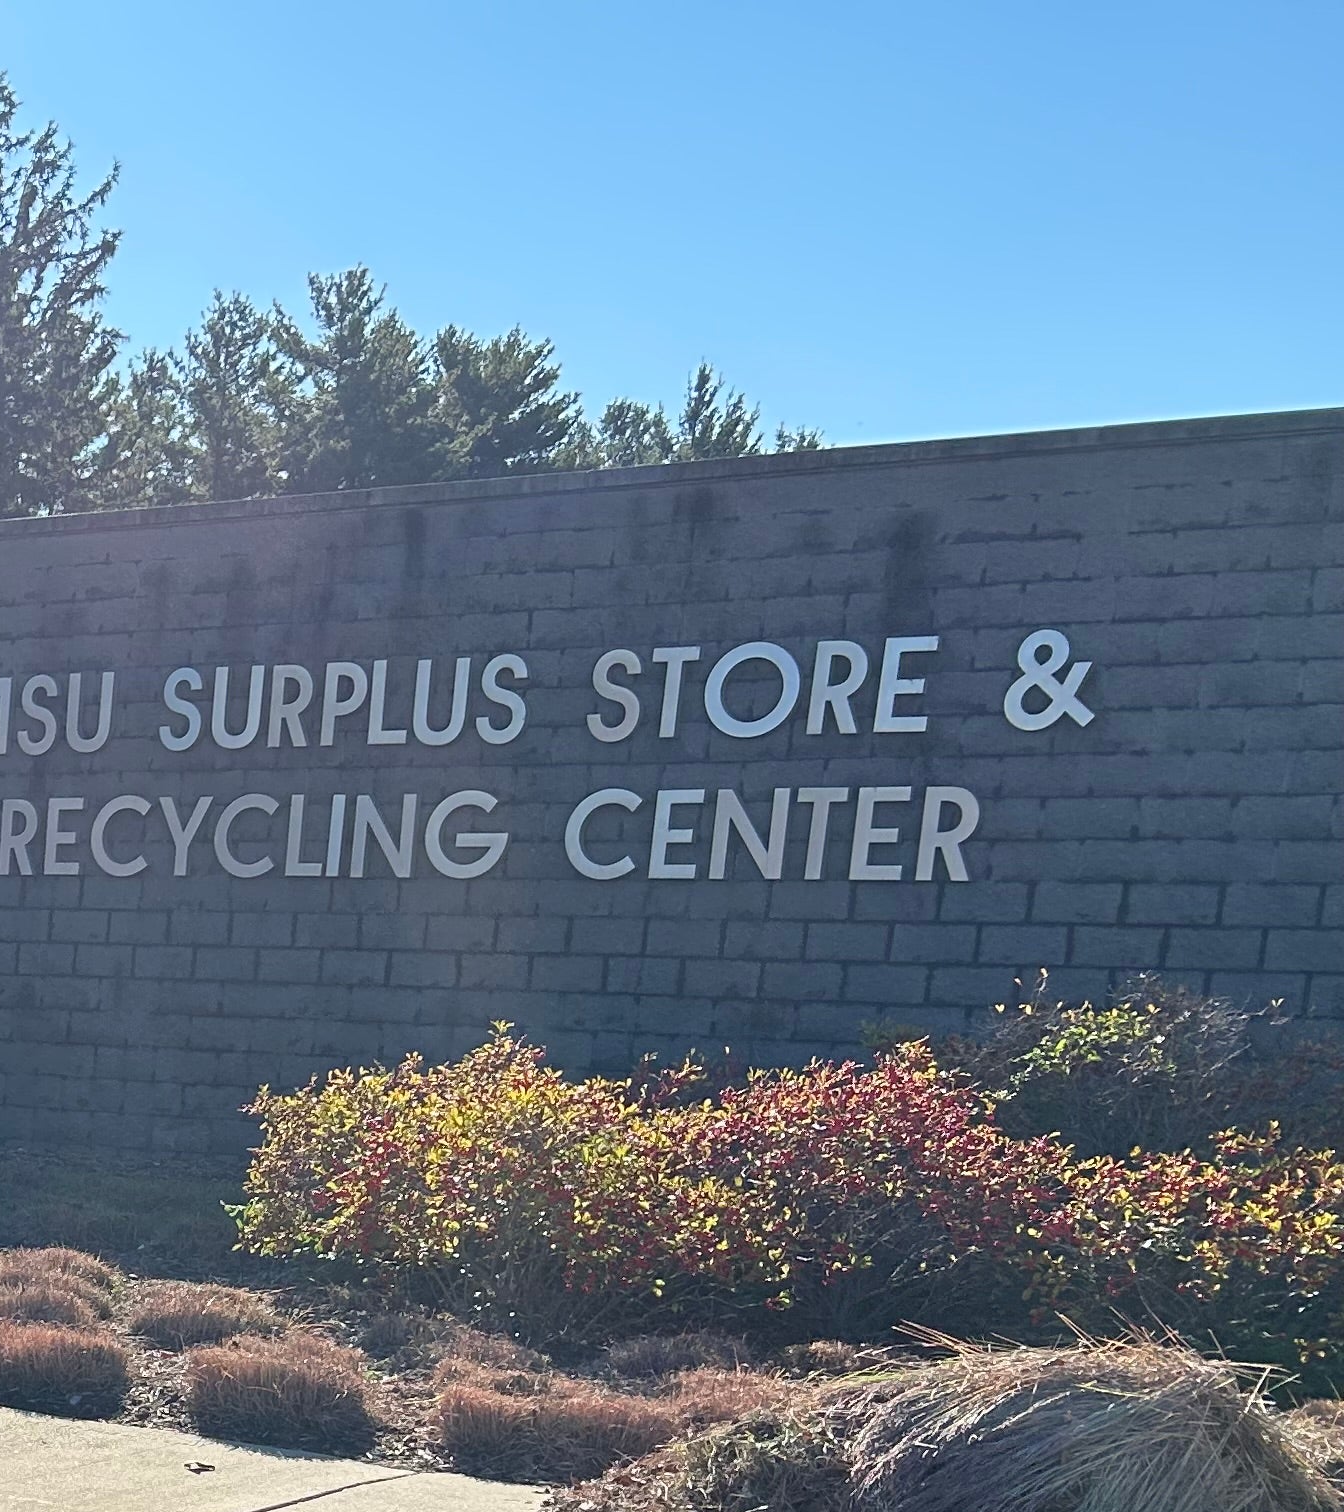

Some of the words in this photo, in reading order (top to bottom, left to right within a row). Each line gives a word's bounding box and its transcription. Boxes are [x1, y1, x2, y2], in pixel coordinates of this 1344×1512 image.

[159, 653, 529, 752] SURPLUS
[586, 635, 940, 743] STORE
[1003, 629, 1096, 732] &
[564, 785, 980, 882] CENTER
